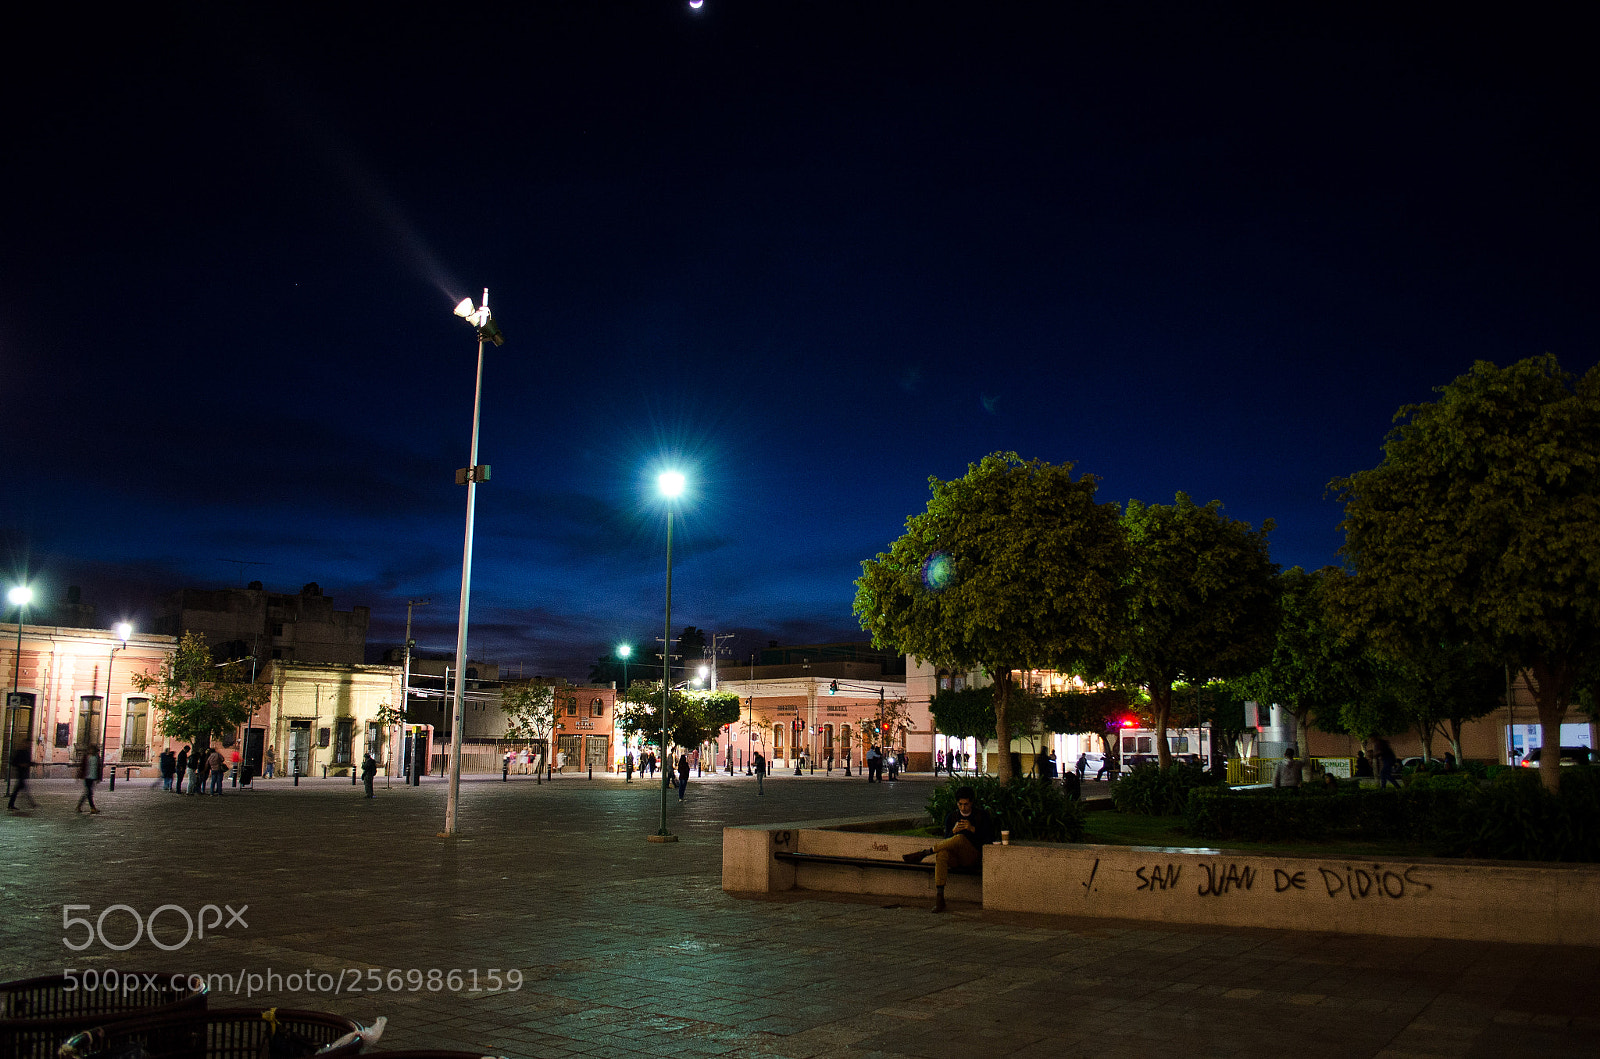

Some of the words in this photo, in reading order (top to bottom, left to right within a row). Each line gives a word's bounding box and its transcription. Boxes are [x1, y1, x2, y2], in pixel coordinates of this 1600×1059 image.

[1136, 864, 1182, 891] SAN
[1198, 863, 1257, 896] JUAN
[1274, 868, 1307, 893] DE
